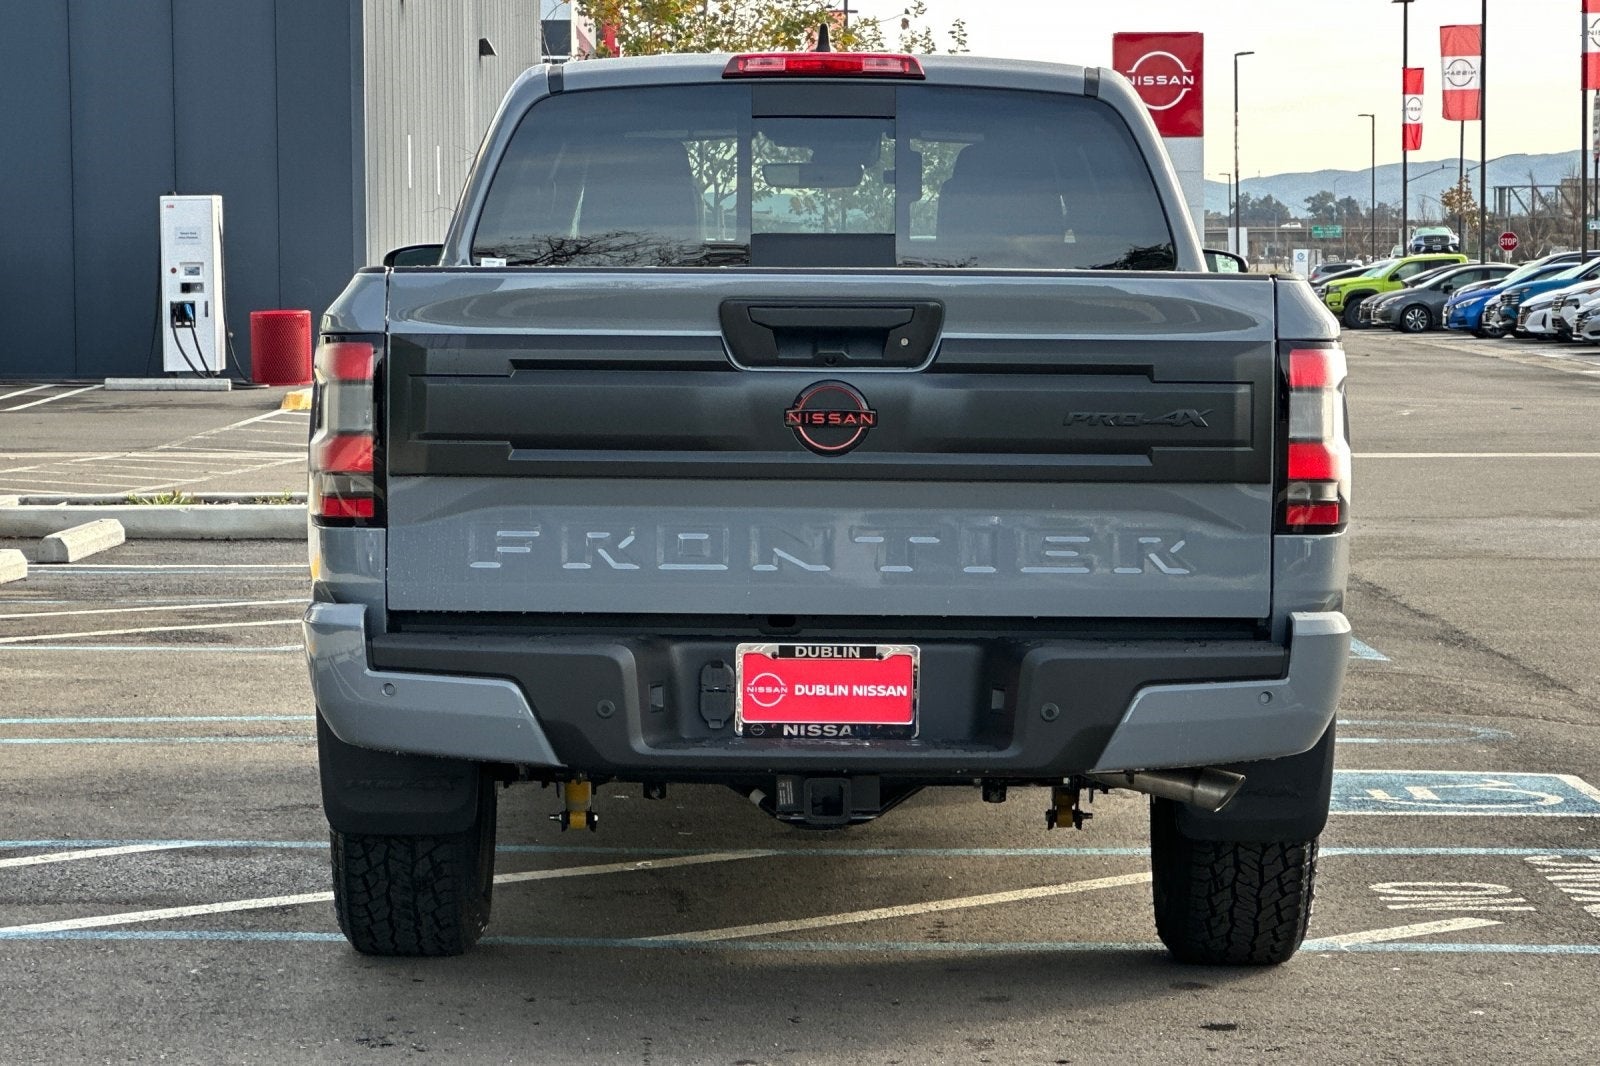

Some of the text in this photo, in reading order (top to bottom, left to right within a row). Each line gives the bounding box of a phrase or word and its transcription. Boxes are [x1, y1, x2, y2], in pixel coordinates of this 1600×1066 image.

[1124, 75, 1194, 86] NISSAN
[1500, 237, 1517, 246] STOP
[788, 412, 873, 425] NISSAN
[1062, 408, 1215, 427] PRO-4X
[467, 521, 1196, 576] FRONTIER
[794, 646, 860, 658] DUBLIN
[794, 684, 908, 697] DUBLIN NISSAN
[783, 724, 870, 737] NISSA
